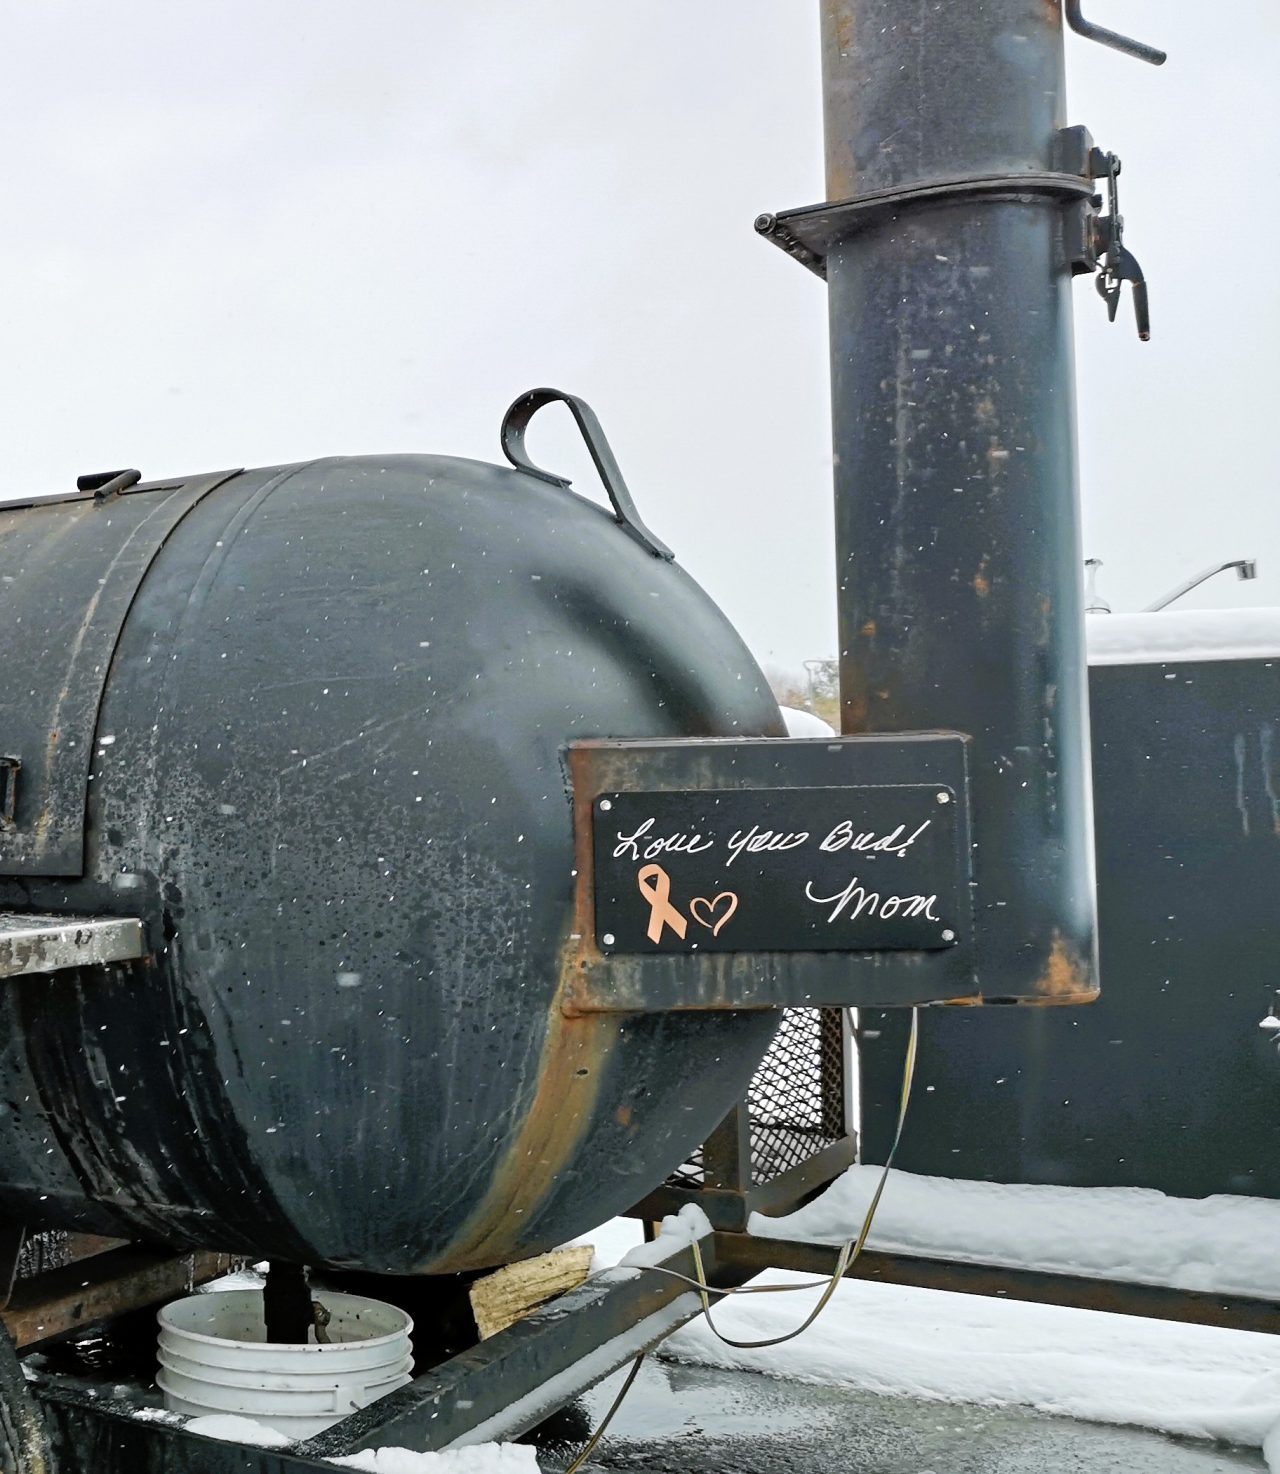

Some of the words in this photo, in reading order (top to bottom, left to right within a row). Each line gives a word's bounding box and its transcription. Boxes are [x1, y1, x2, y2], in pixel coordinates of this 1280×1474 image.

[613, 817, 715, 861] Love
[726, 825, 810, 867] you
[819, 819, 931, 857] Bud!
